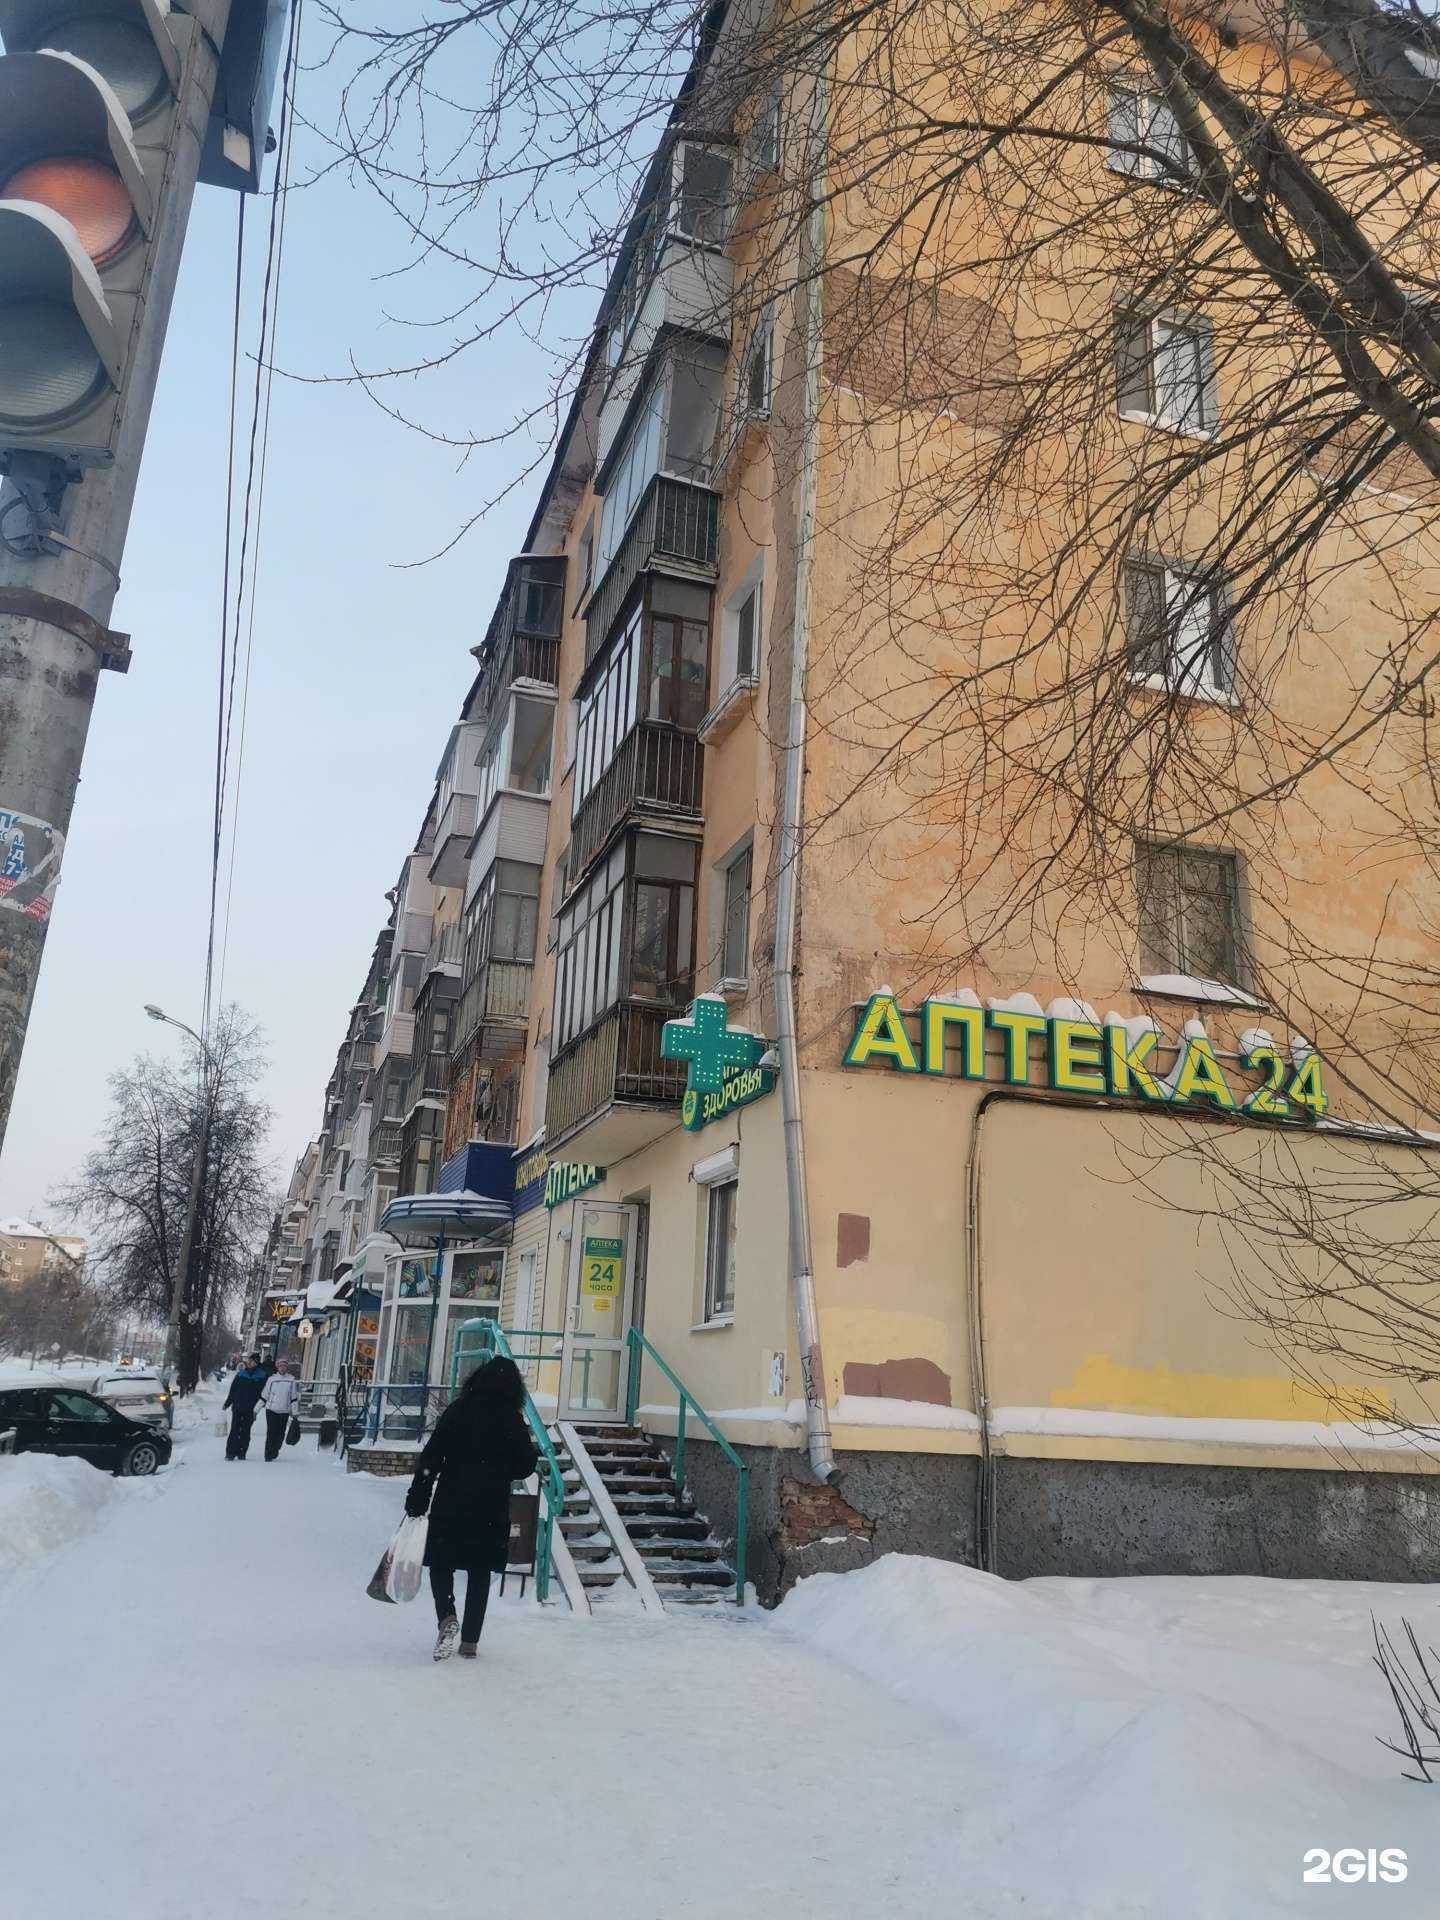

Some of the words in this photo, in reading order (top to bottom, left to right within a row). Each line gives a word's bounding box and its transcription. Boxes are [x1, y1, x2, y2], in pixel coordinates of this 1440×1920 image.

[843, 994, 1238, 1113] АПТЕКА
[1242, 1045, 1328, 1119] 24
[702, 1068, 762, 1119] ЗДОРОВЬЯ
[544, 1161, 596, 1208] АПТЕКА
[590, 1239, 619, 1249] АПТЕКА
[589, 1263, 615, 1283] 24
[589, 1284, 613, 1292] часа
